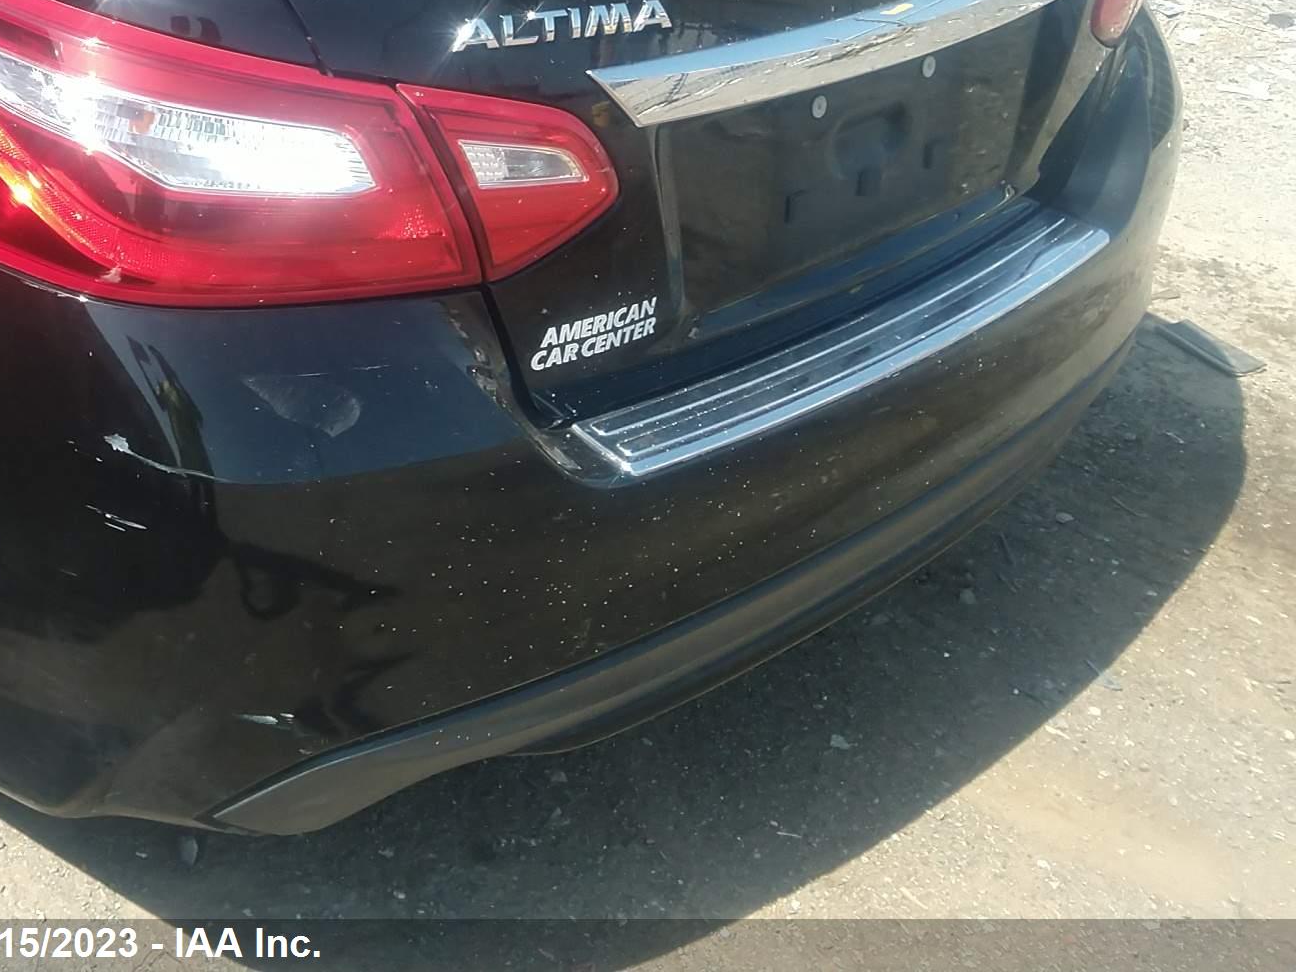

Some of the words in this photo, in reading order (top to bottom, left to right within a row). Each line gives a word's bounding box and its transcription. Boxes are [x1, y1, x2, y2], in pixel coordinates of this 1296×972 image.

[451, 0, 673, 52] ALTIMA
[530, 343, 579, 371] CAR
[580, 316, 657, 357] CENTER
[539, 296, 657, 348] AMERICAN
